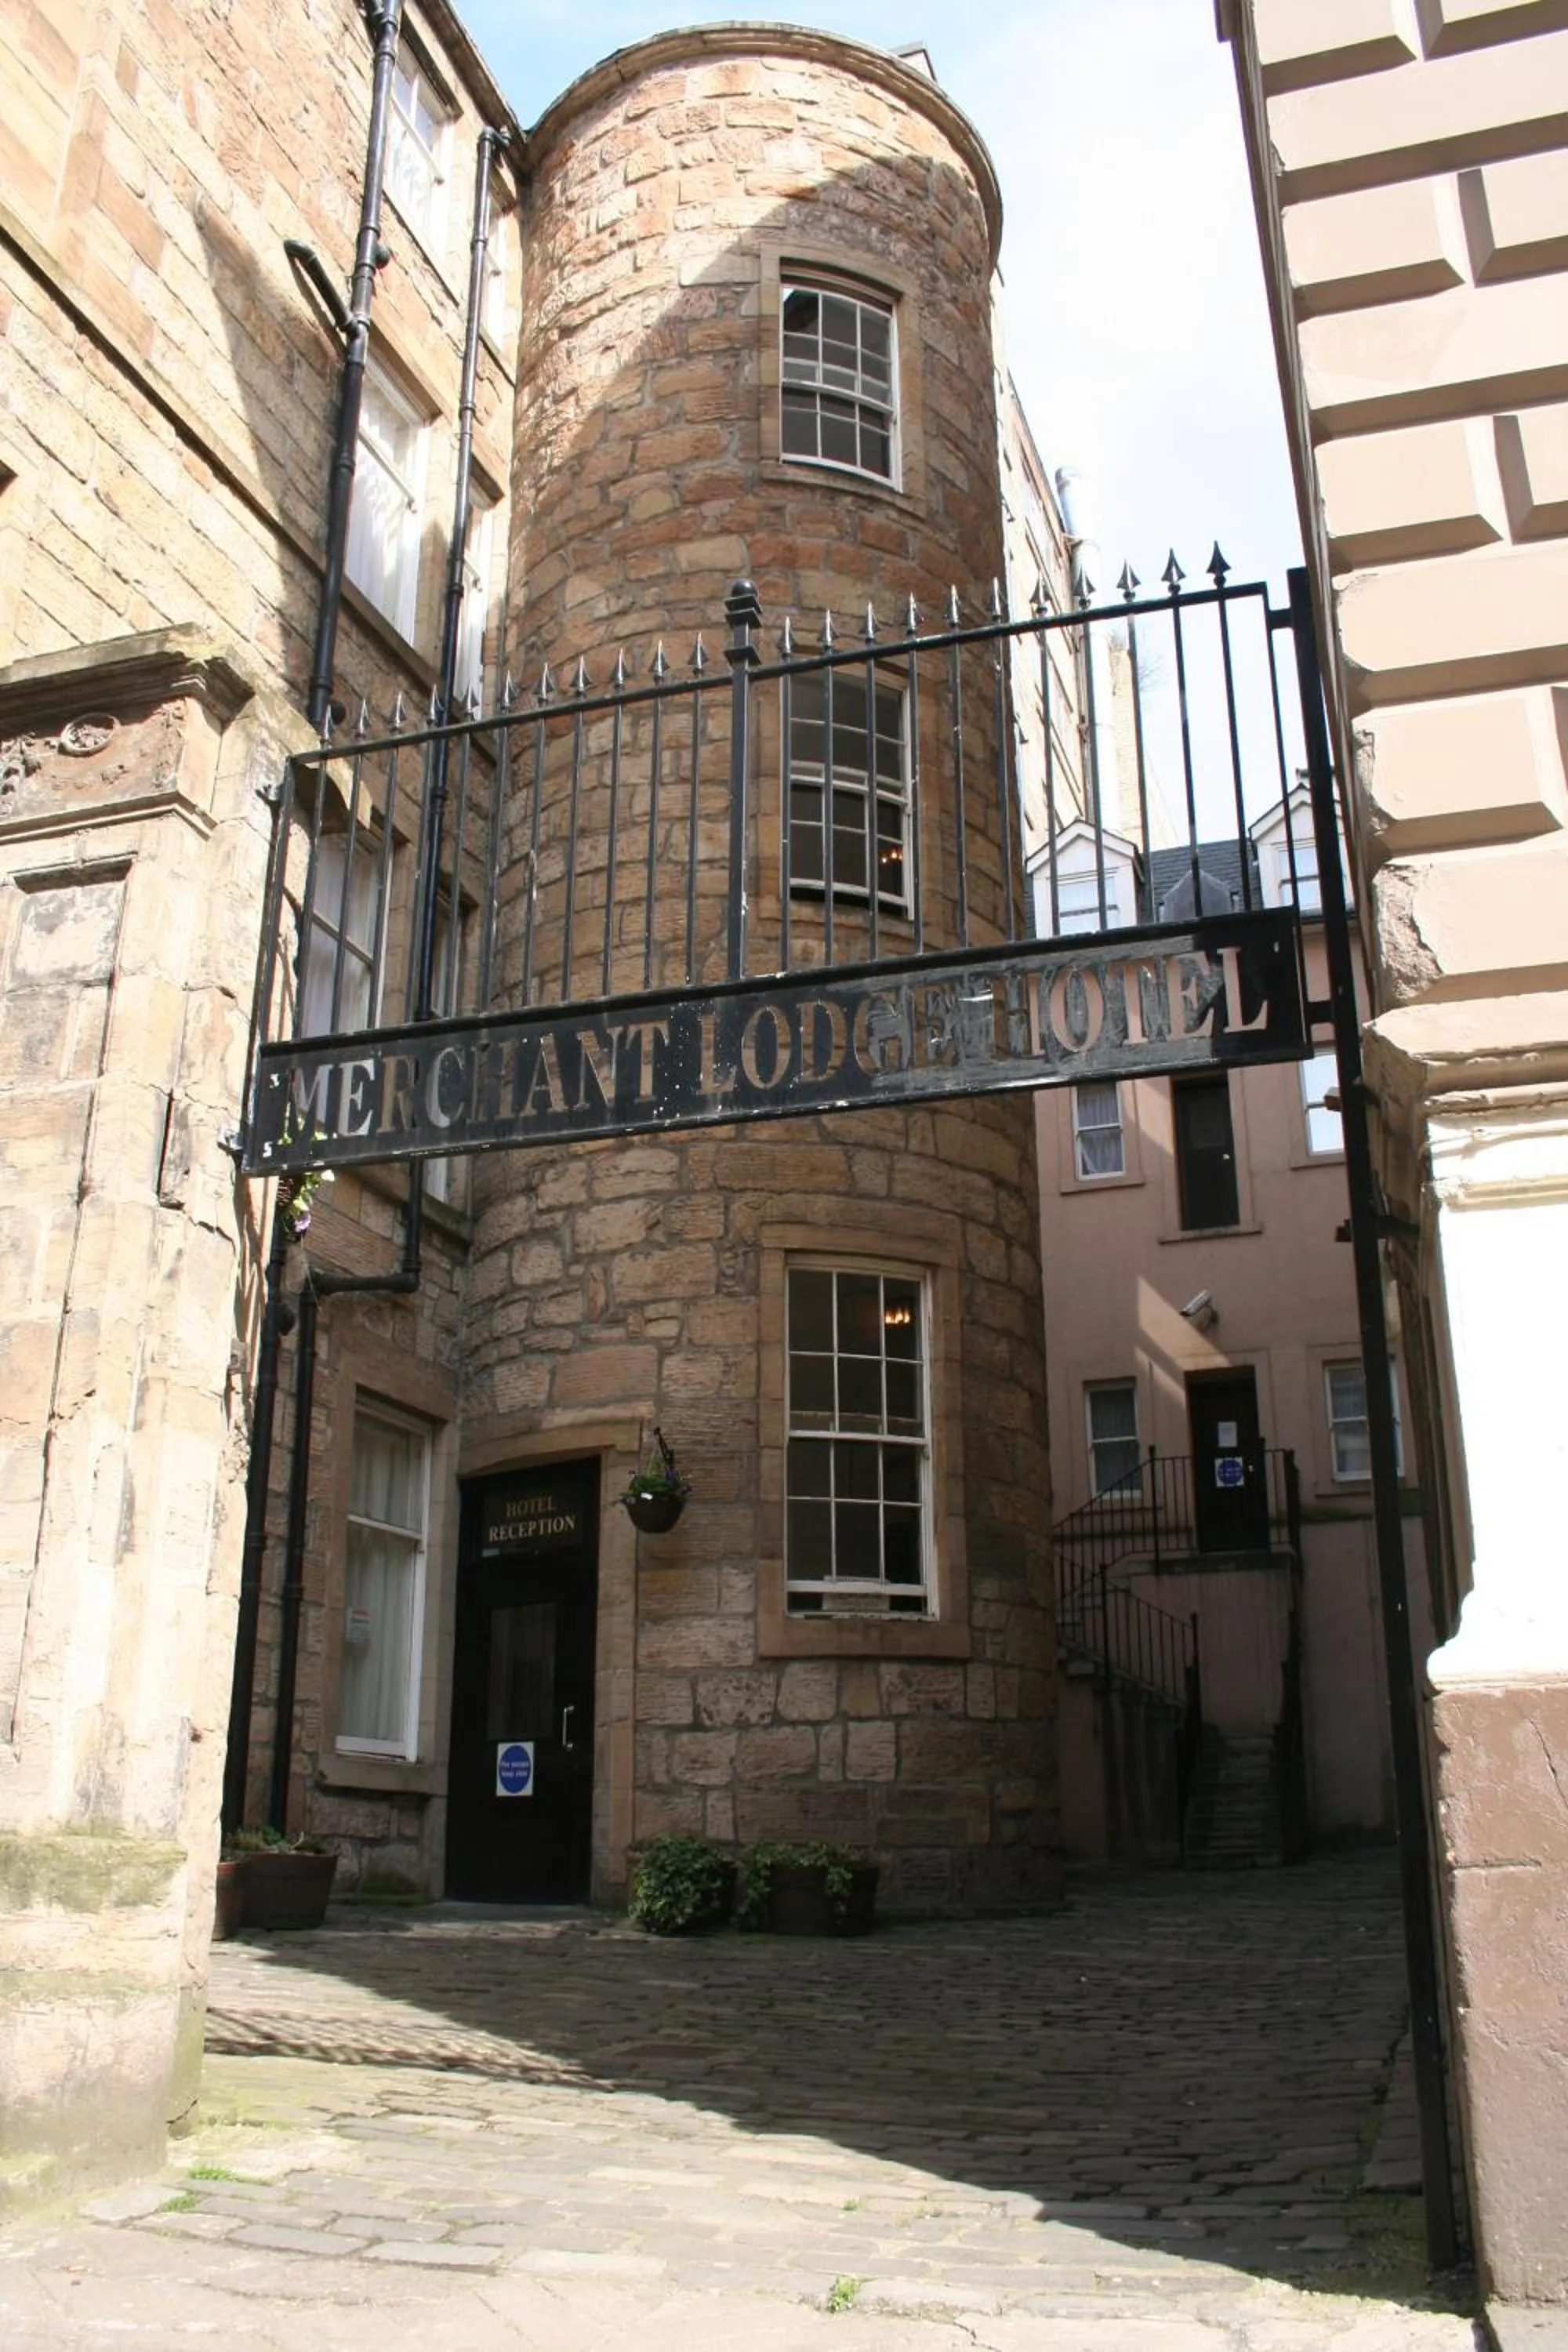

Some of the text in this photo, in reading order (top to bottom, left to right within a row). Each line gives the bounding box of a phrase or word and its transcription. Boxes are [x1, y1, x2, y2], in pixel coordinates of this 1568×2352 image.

[278, 946, 1269, 1144] MERCHANT LODGE HOTEL
[505, 1495, 557, 1518] HOTEL
[488, 1514, 577, 1542] RECEPTION
